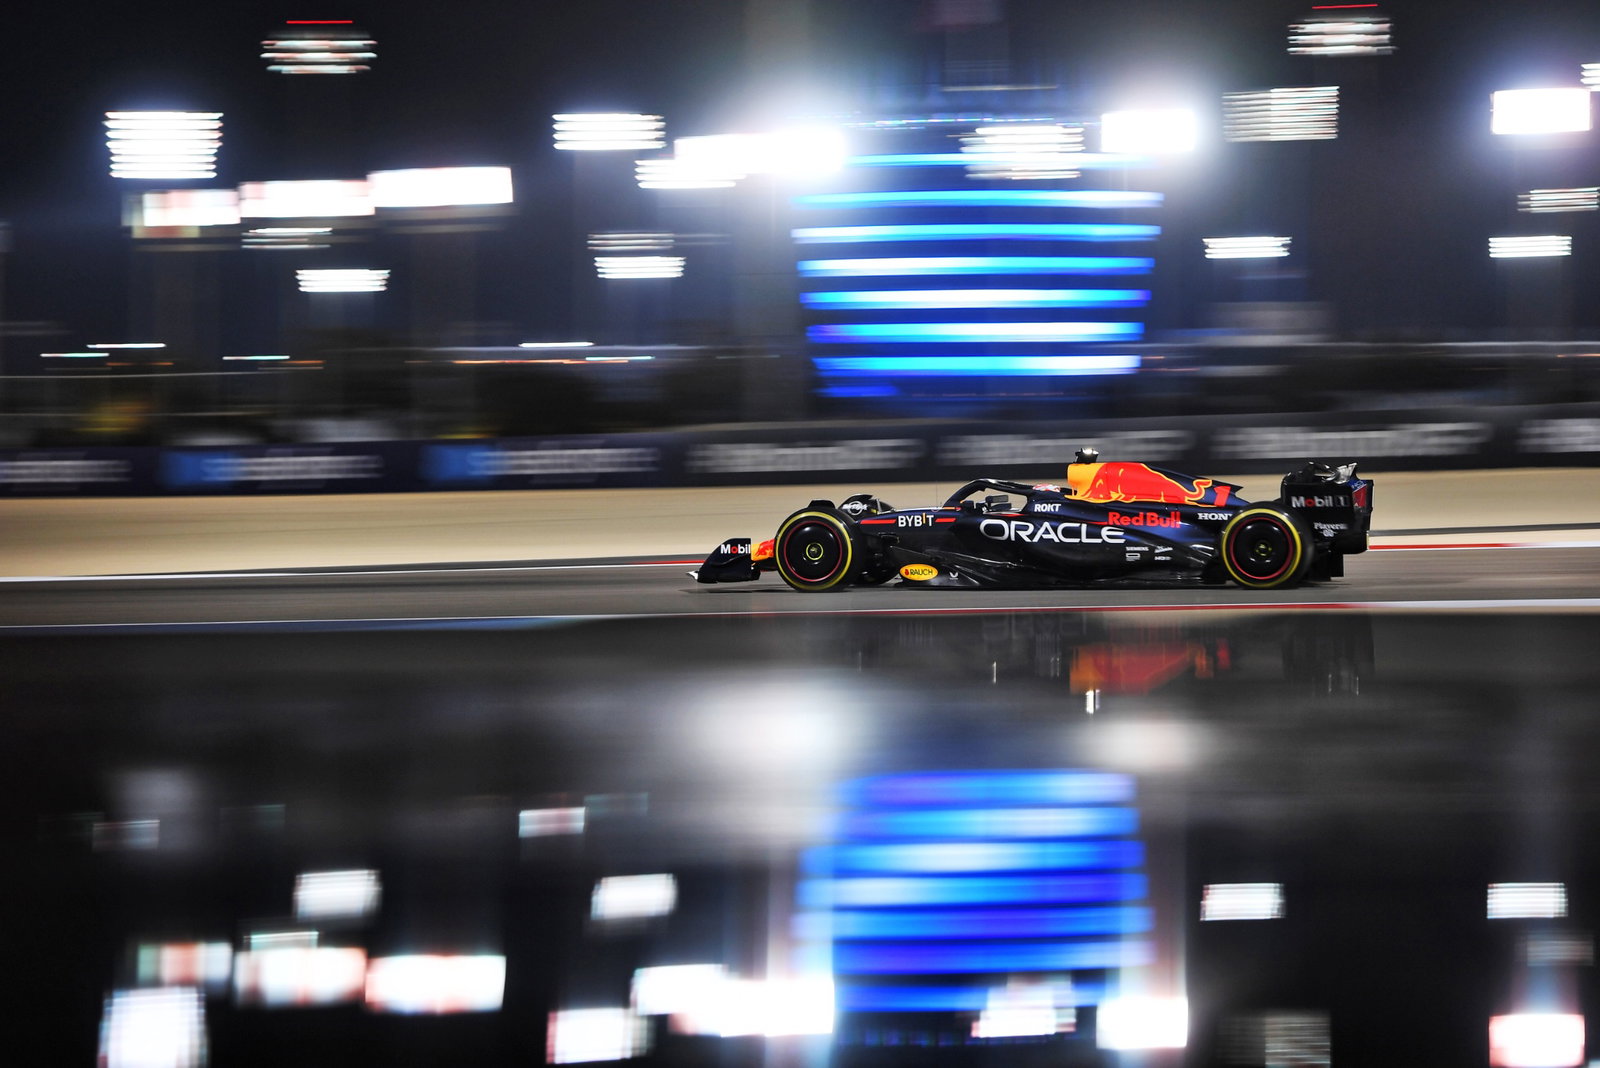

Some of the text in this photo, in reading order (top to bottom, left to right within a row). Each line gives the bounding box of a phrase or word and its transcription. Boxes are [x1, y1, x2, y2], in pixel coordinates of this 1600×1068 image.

[1213, 485, 1232, 507] 1
[1291, 495, 1333, 508] Mobil
[1034, 503, 1061, 513] ROKT
[898, 512, 935, 527] BYBIT
[1108, 511, 1181, 529] Red Bull
[1198, 513, 1233, 521] HON
[979, 518, 1127, 544] ORACLE
[720, 543, 751, 555] Mobil
[909, 568, 934, 576] RAUCH
